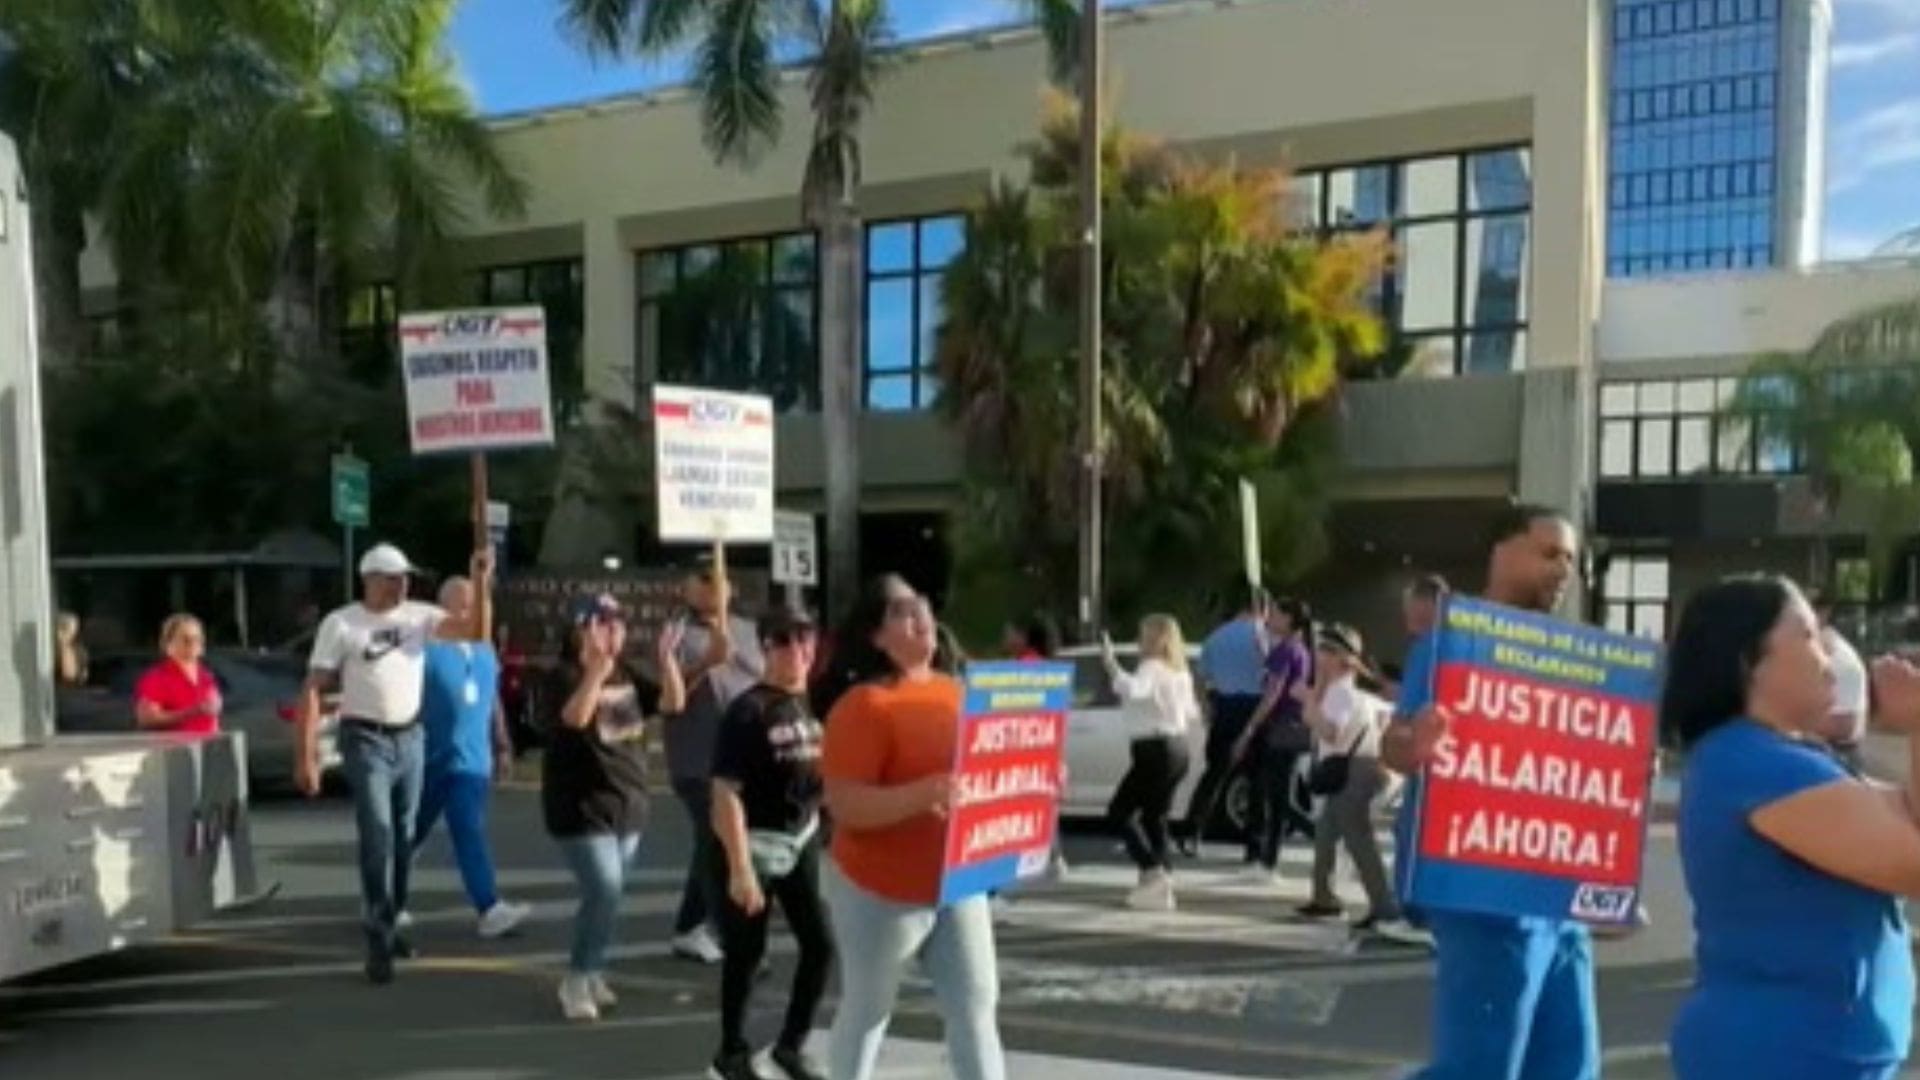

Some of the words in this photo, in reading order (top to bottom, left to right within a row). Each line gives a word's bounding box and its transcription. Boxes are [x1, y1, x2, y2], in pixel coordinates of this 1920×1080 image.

[479, 349, 538, 372] RESPETO
[457, 379, 495, 406] PARA
[781, 550, 811, 576] 15
[1448, 606, 1548, 645] EMPLEADOS
[1552, 632, 1573, 649] DE
[1579, 638, 1597, 657] LA
[1603, 642, 1655, 668] SALUD
[1455, 670, 1636, 747] JUSTICIA
[970, 717, 1056, 755] JUSTICIA
[1431, 733, 1642, 817] SALARIAL,
[1447, 809, 1620, 871] ¡AHORA!
